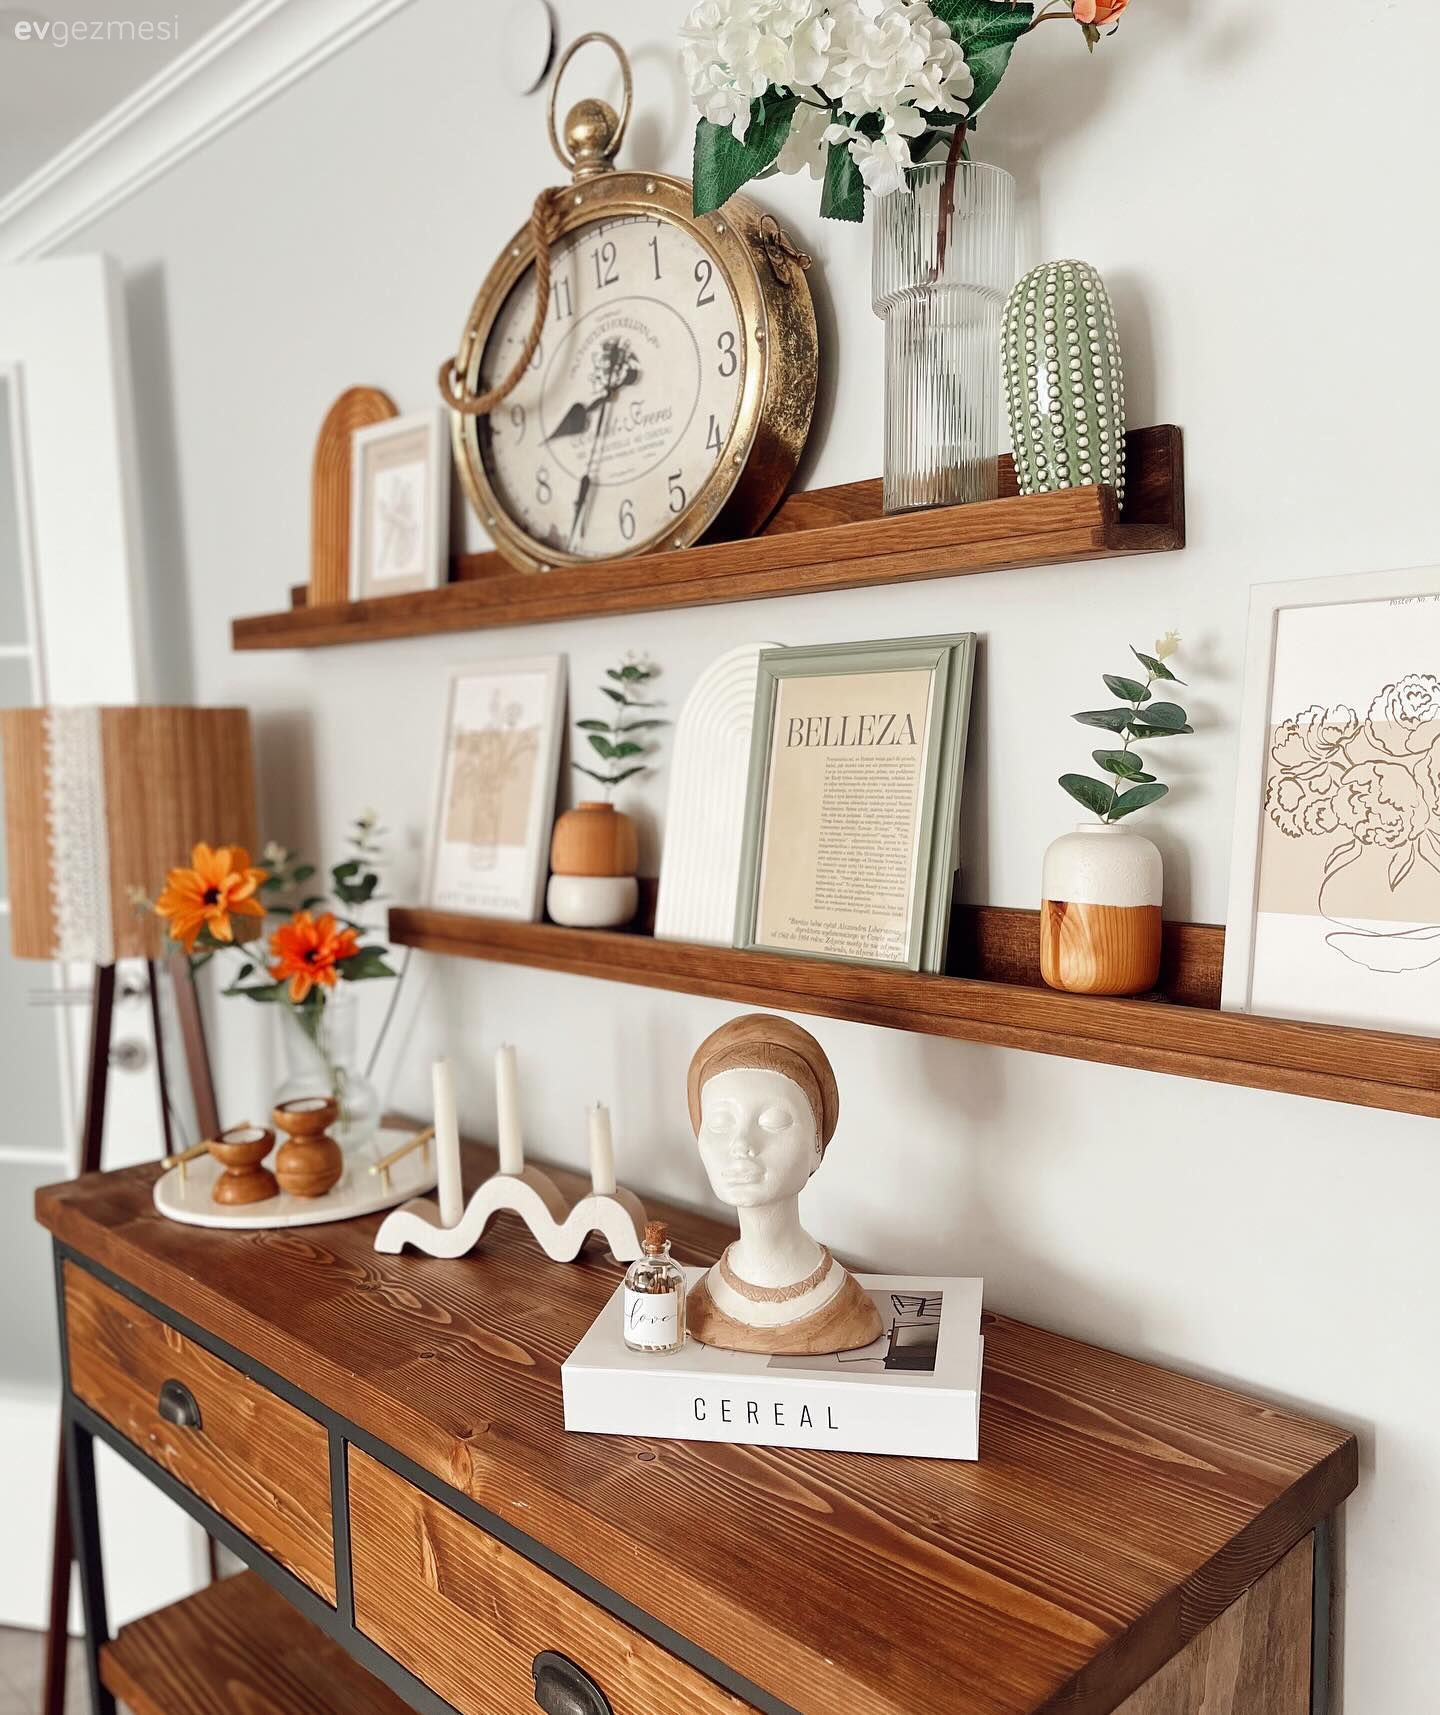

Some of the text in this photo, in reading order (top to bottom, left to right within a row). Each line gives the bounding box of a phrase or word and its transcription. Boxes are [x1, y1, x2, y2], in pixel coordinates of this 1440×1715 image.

[590, 241, 620, 290] 12
[648, 236, 663, 281] 1
[551, 276, 573, 321] 11
[694, 259, 716, 308] 2
[717, 331, 738, 378] 3
[509, 404, 526, 447] 9
[705, 414, 724, 458] 4
[536, 468, 553, 505] 8
[668, 469, 687, 514] 5
[618, 499, 636, 540] 6
[786, 713, 918, 748] BELLEZA
[626, 1298, 674, 1330] love
[693, 1397, 839, 1430] CEREAL
